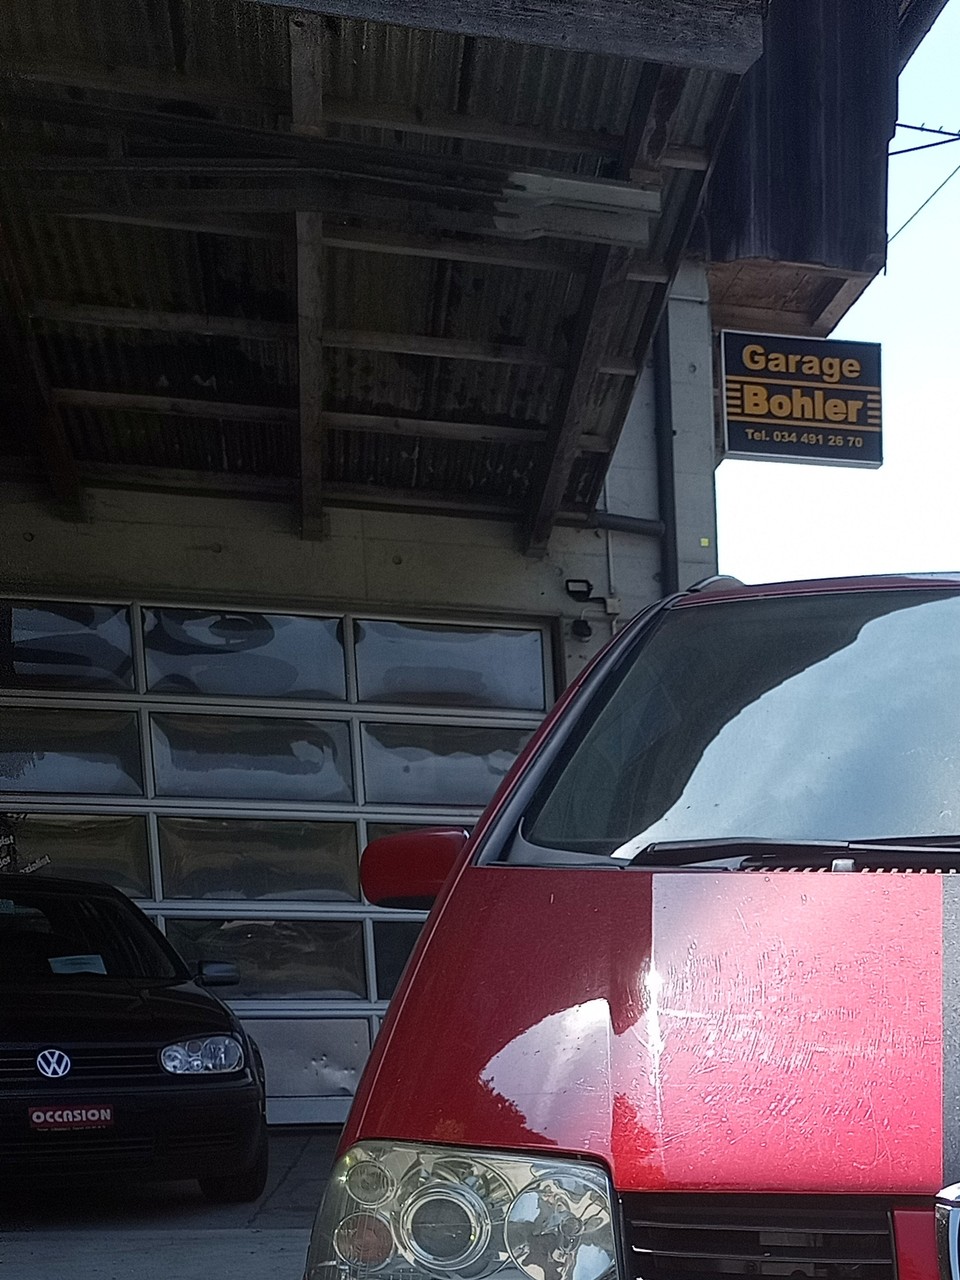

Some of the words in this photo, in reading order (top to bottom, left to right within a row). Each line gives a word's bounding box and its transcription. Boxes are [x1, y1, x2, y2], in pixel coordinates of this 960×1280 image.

[742, 344, 861, 383] Garage
[743, 384, 864, 423] Bohler
[745, 428, 770, 441] Tel.
[773, 431, 797, 443] 034
[800, 432, 824, 445] 491
[847, 436, 863, 448] 70
[32, 1109, 111, 1123] OCCASION
